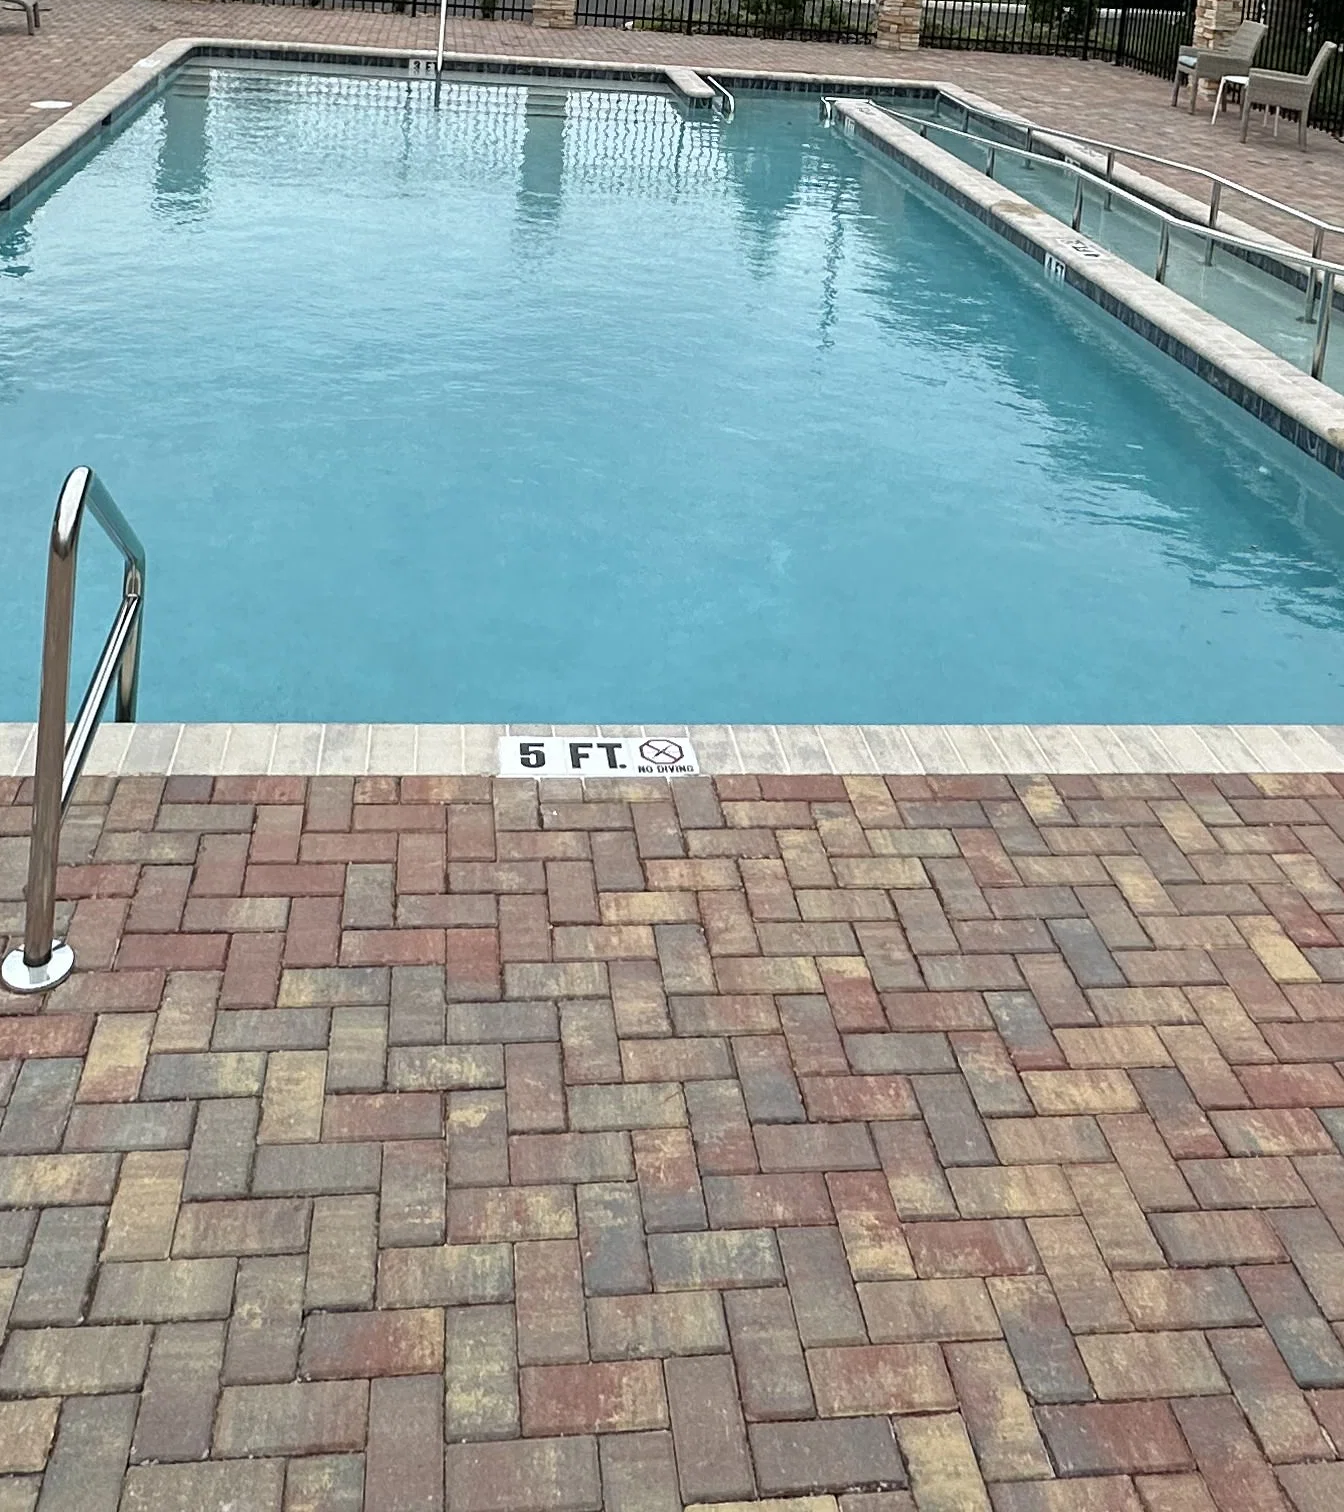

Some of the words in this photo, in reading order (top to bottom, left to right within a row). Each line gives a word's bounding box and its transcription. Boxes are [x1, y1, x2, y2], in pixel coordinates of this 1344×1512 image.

[519, 742, 547, 769] 5
[568, 742, 628, 769] FT.
[638, 764, 654, 774] NO
[657, 764, 695, 774] DIVING
